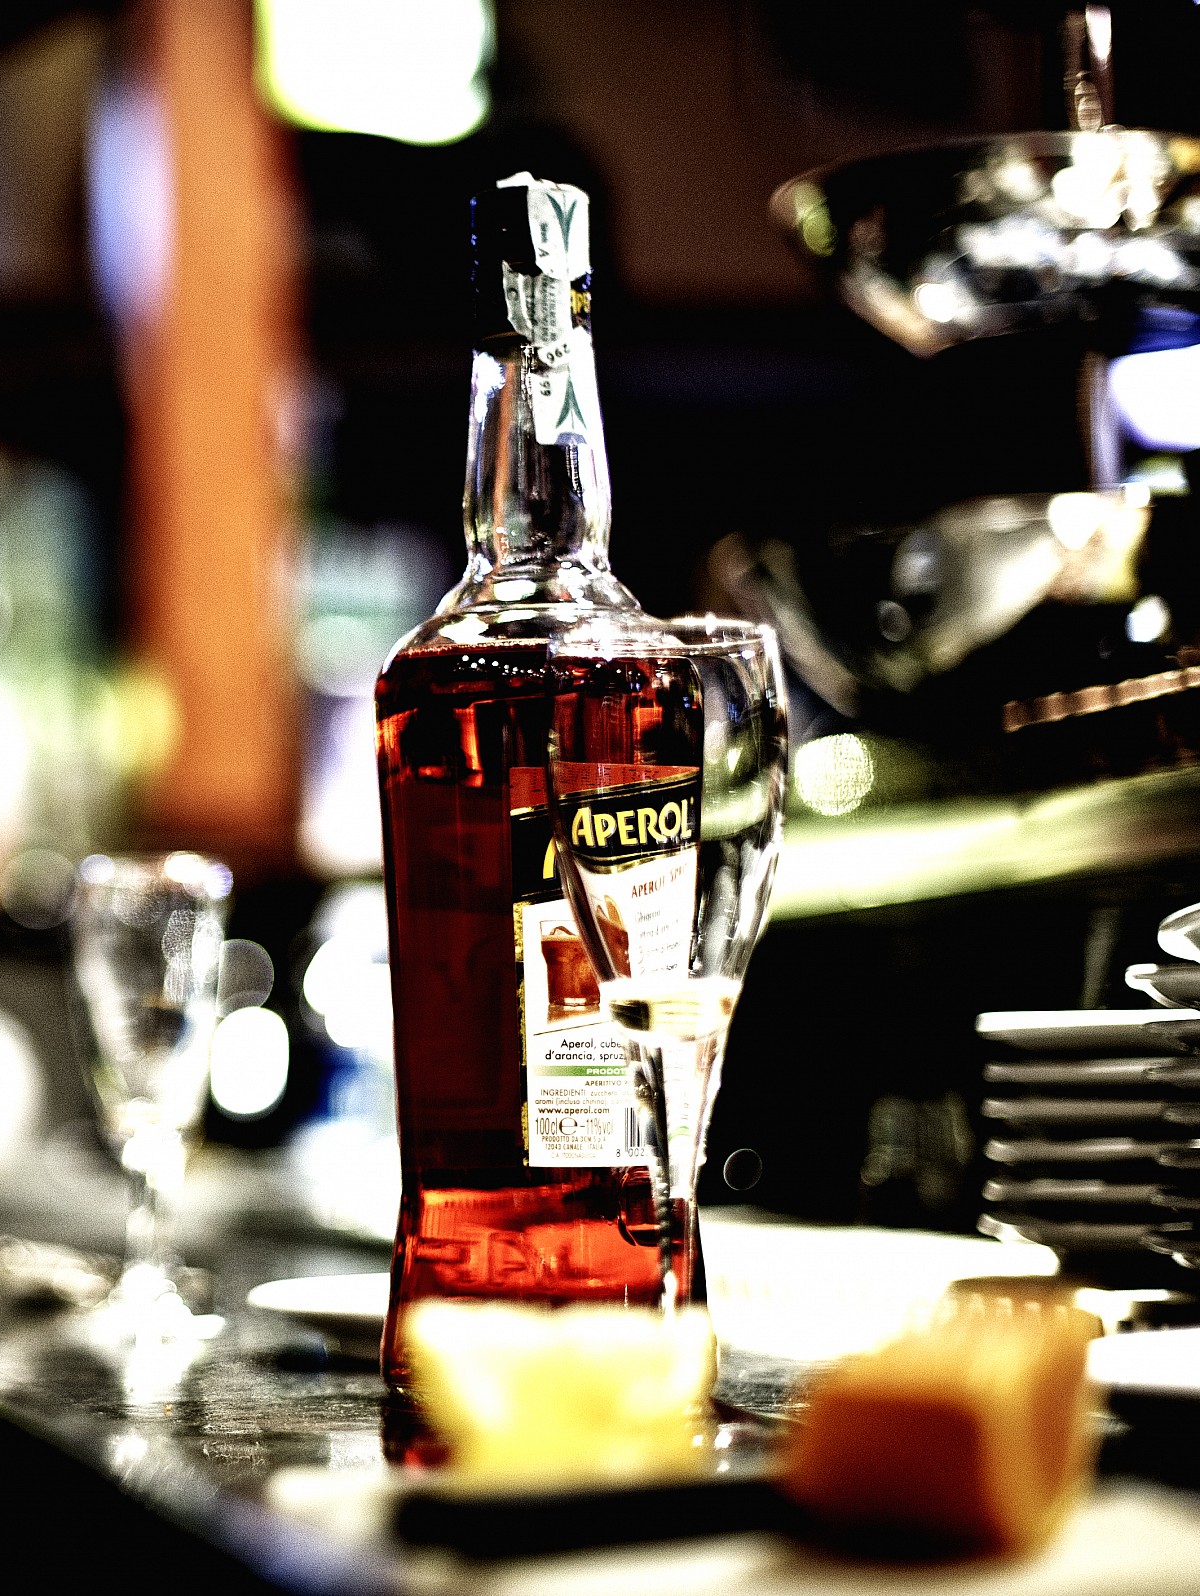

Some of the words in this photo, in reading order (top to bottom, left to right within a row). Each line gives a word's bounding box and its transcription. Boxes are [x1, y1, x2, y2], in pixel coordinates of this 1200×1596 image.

[571, 797, 692, 848] APEROL
[560, 1038, 597, 1051] Aperol,
[600, 1038, 622, 1049] cube
[545, 1050, 596, 1062] d'arancia,
[599, 1052, 626, 1063] spruz
[537, 1106, 610, 1116] www.aperol.com
[628, 1147, 647, 1158] 002
